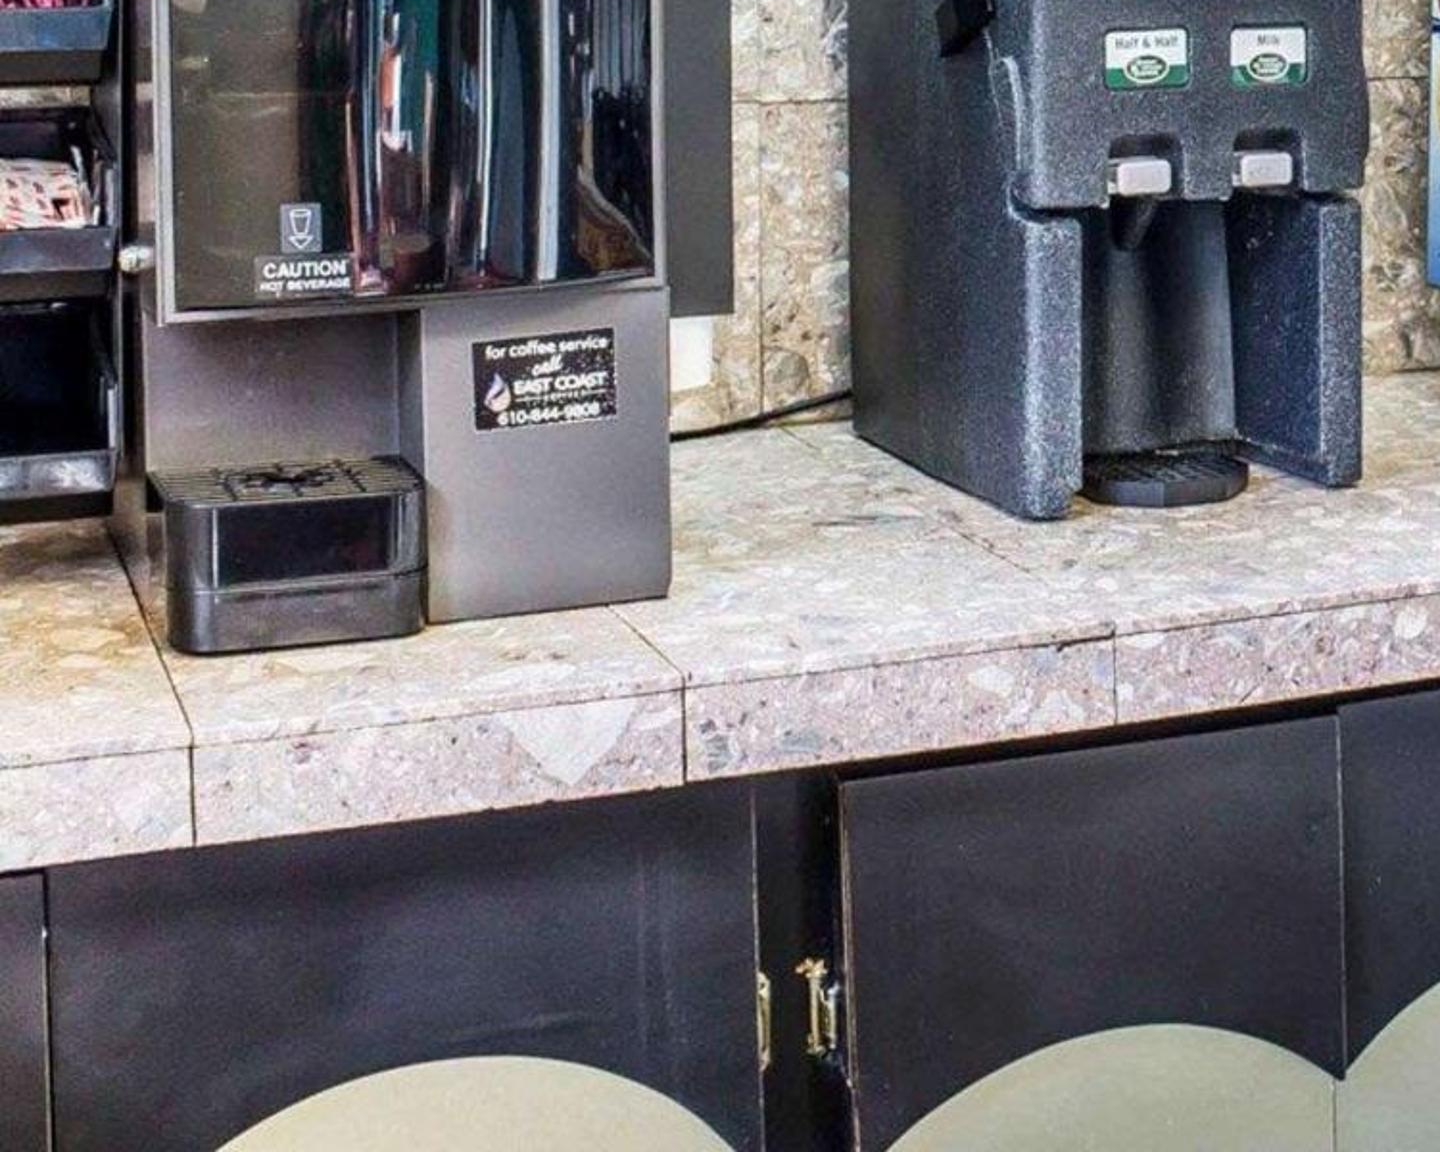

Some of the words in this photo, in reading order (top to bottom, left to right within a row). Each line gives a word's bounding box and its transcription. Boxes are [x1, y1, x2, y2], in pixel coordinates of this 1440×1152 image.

[262, 259, 347, 279] CAUTION
[260, 280, 283, 292] HOT
[287, 277, 351, 291] BEVERAGE
[485, 344, 507, 361] for
[509, 339, 556, 358] coffee
[559, 335, 609, 352] service
[513, 377, 553, 397] EAST
[554, 371, 609, 391] COAST
